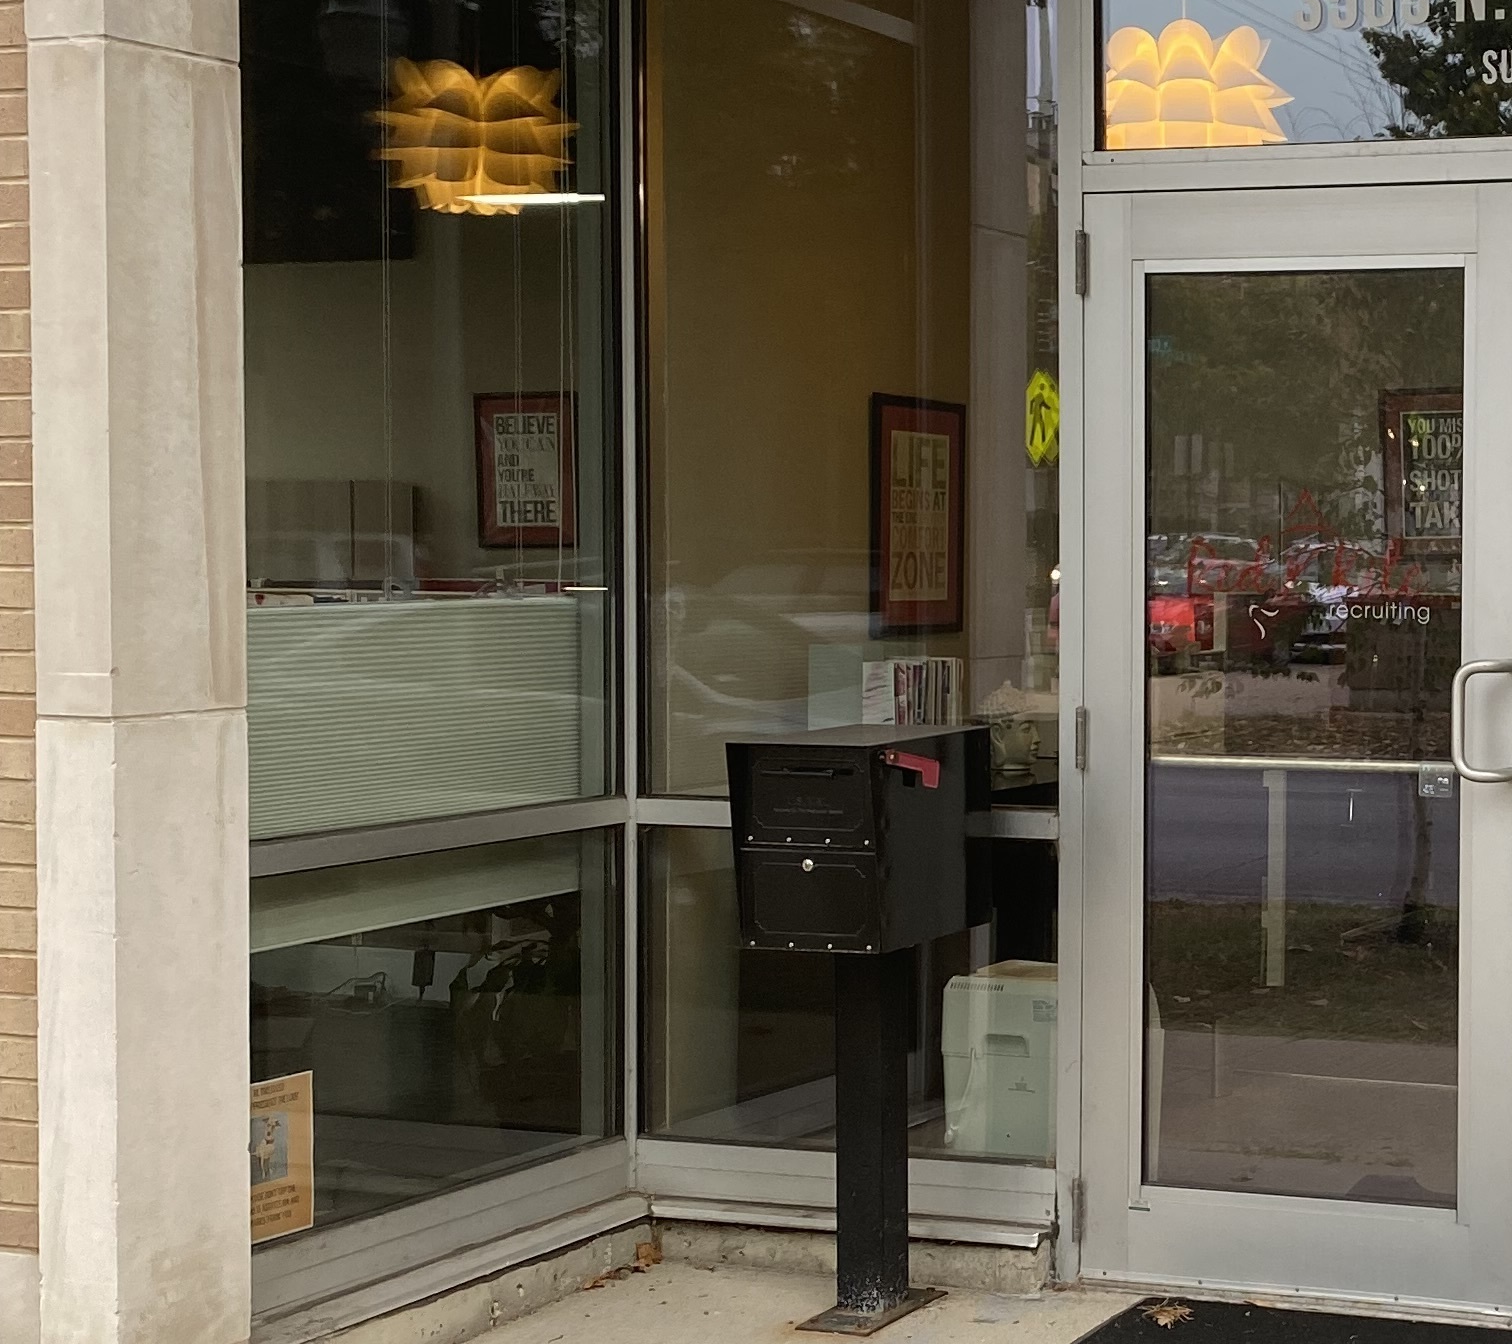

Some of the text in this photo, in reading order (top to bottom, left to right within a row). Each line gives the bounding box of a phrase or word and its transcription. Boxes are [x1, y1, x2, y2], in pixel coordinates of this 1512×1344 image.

[495, 415, 555, 435] BELIEVE
[1408, 417, 1463, 434] YOU MIS
[498, 454, 520, 467] AND
[892, 436, 947, 489] LIFE
[1409, 470, 1462, 492] SHOT
[892, 489, 946, 511] BEGINS AT
[498, 500, 556, 523] THERE
[1409, 501, 1461, 529] TAK
[891, 551, 946, 590] ZONE
[1329, 600, 1431, 625] recruiting
